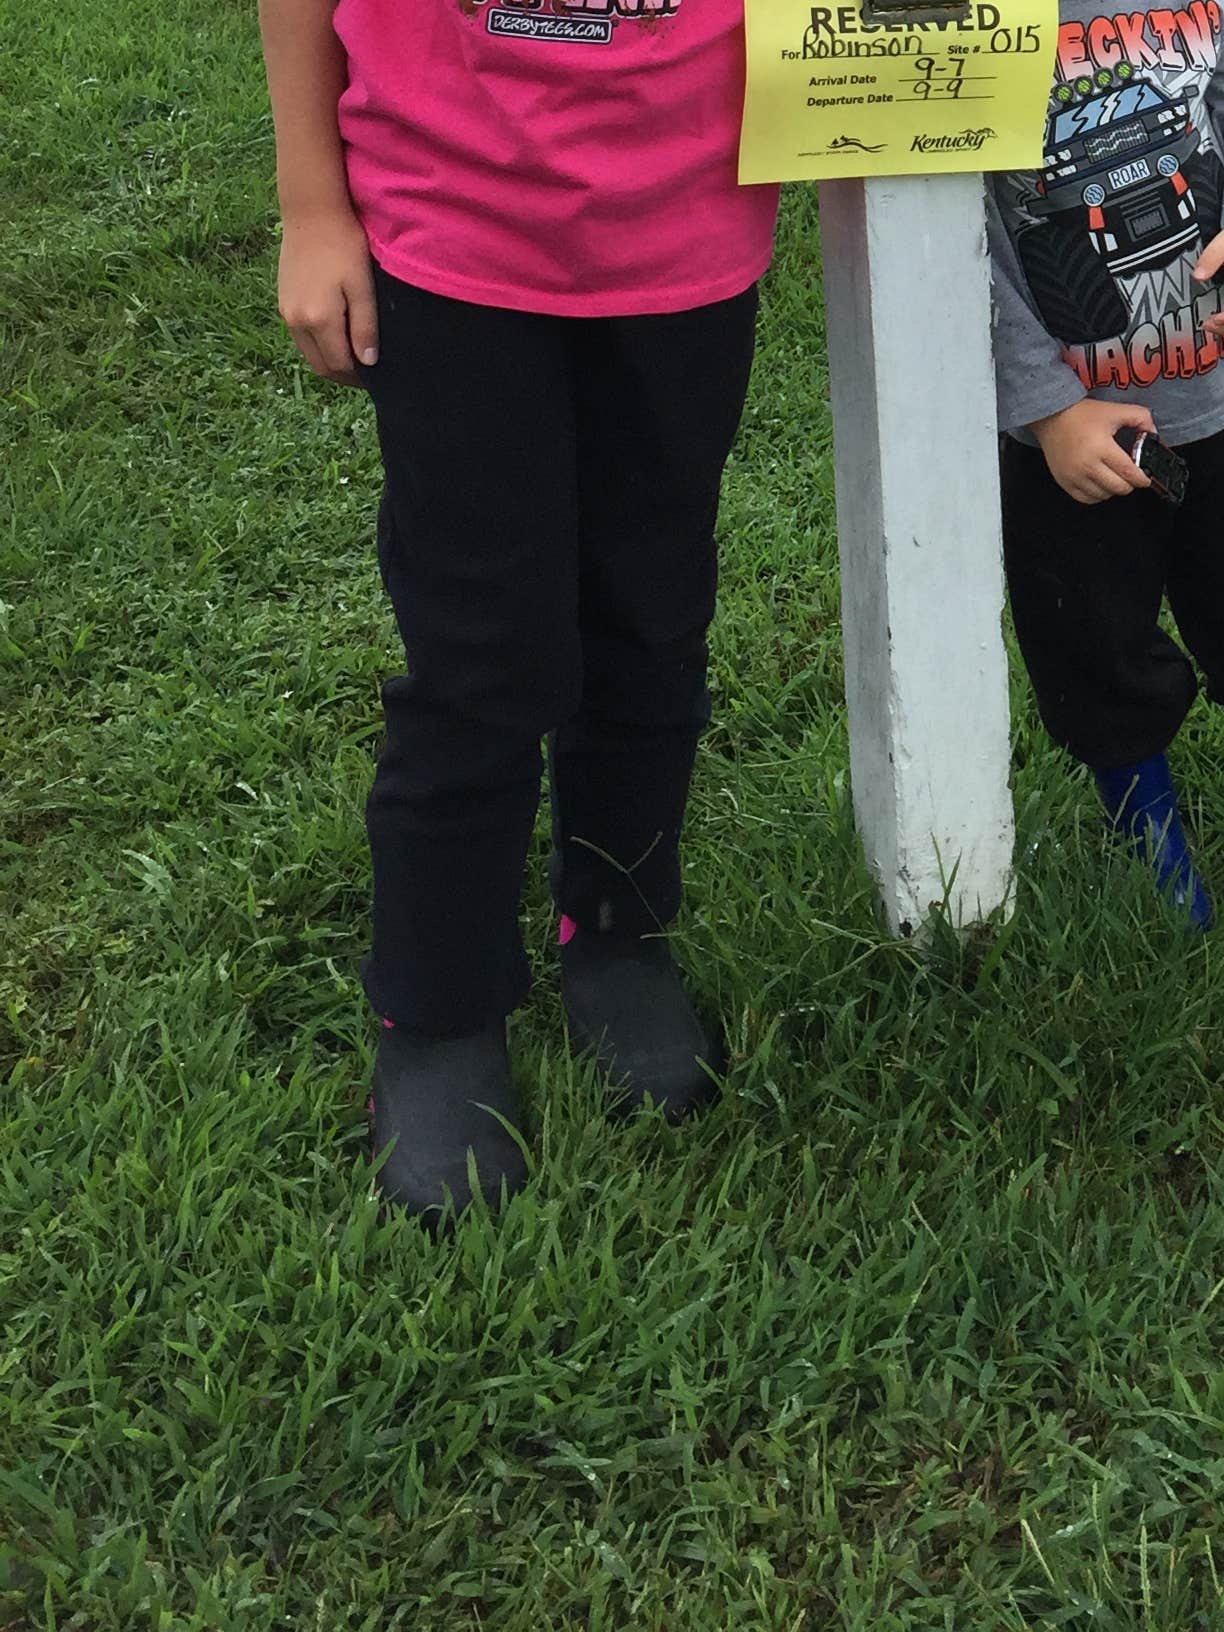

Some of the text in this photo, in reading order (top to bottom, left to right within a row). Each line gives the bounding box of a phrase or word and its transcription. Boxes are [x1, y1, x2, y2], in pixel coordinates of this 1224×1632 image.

[493, 14, 606, 37] DERBYTEES.COM
[781, 49, 800, 60] For
[802, 24, 922, 60] Robinson
[947, 44, 970, 55] Site
[990, 24, 1042, 53] 015
[1056, 0, 1222, 83] ECKIN'
[809, 57, 966, 86] Arrival Date 9-7
[807, 78, 963, 107] Departure Date 9-9
[910, 132, 986, 154] Kentucky
[1110, 160, 1148, 188] ROAR
